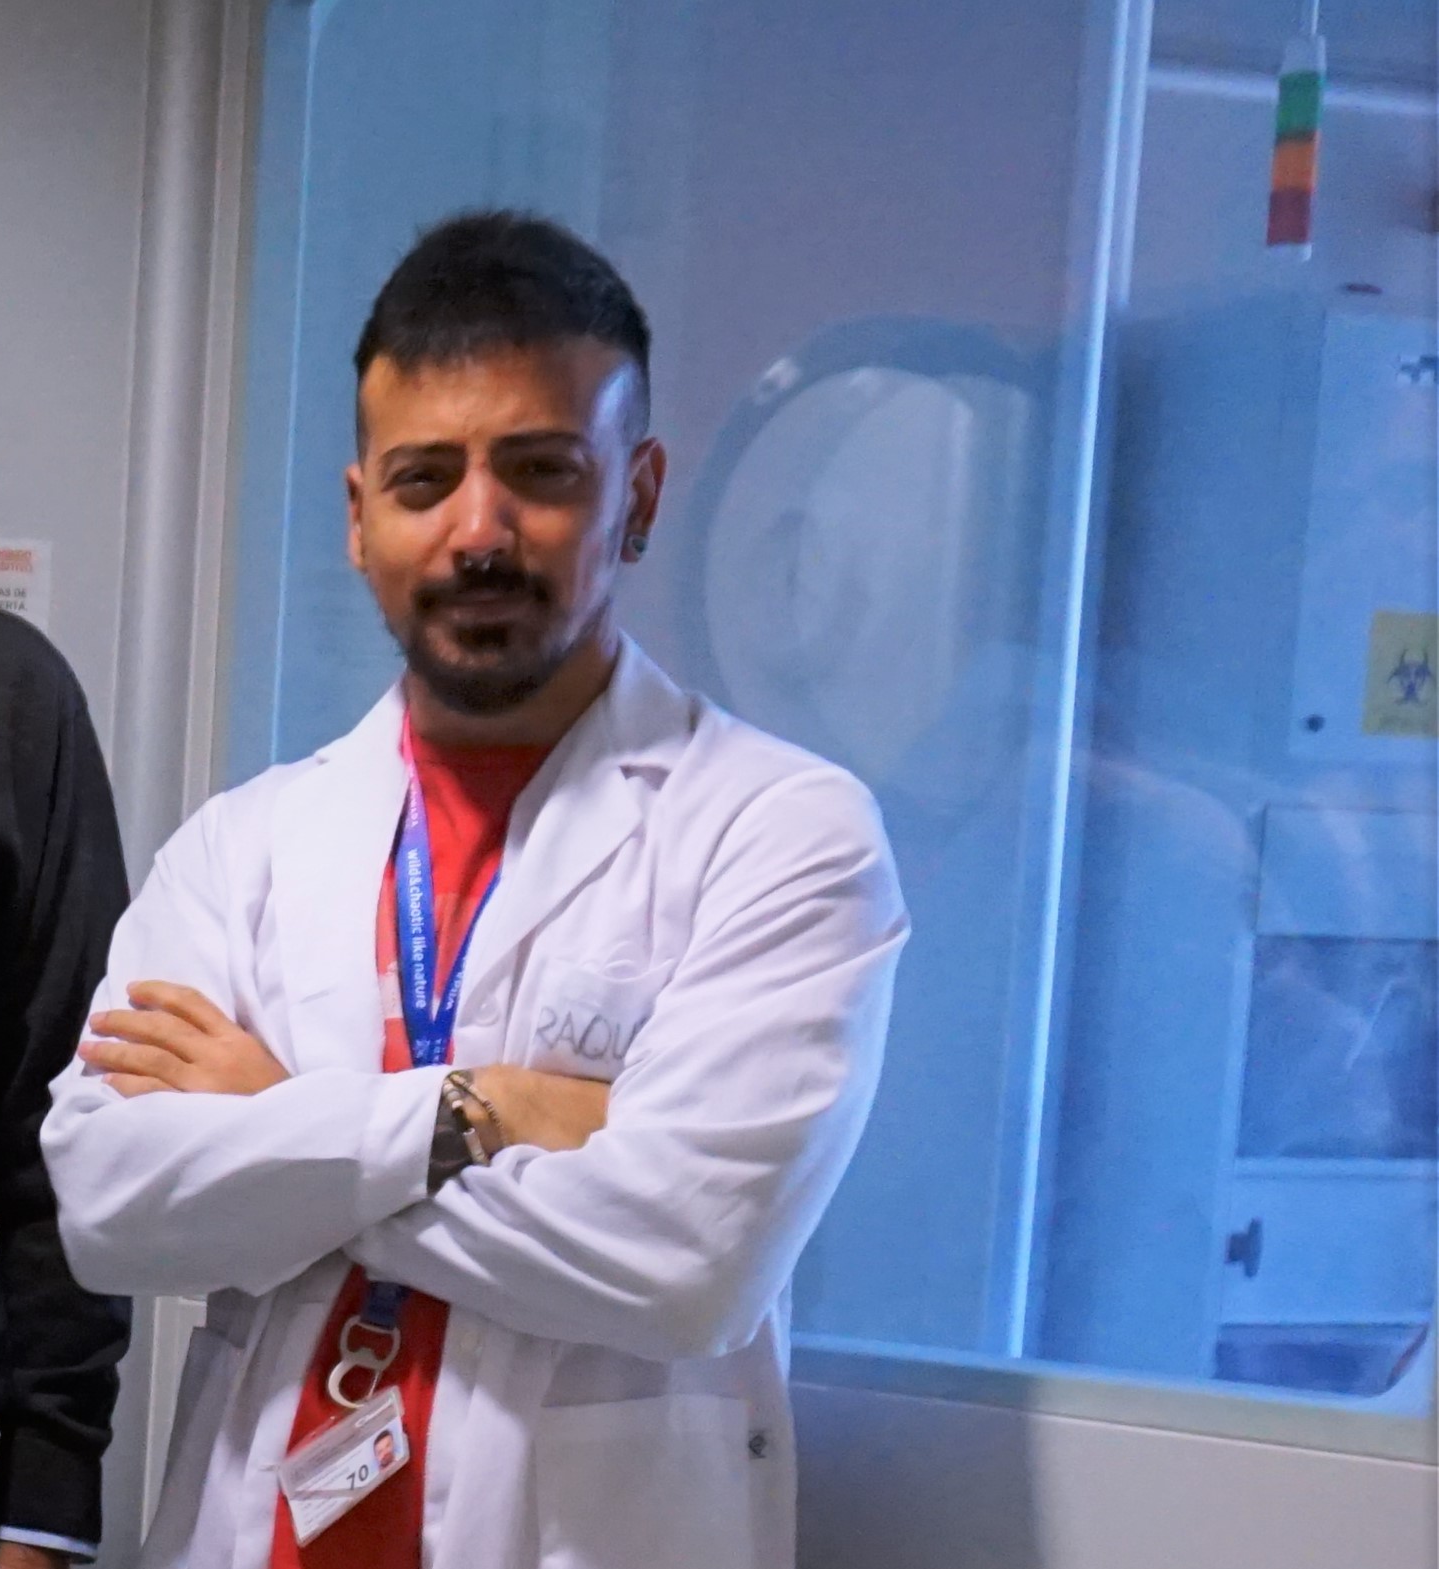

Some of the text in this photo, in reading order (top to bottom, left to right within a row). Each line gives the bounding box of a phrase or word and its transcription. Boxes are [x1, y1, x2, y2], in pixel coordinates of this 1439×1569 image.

[14, 588, 27, 599] DE
[407, 848, 427, 1010] wild&chaotic like nature
[536, 1006, 649, 1060] RAQU
